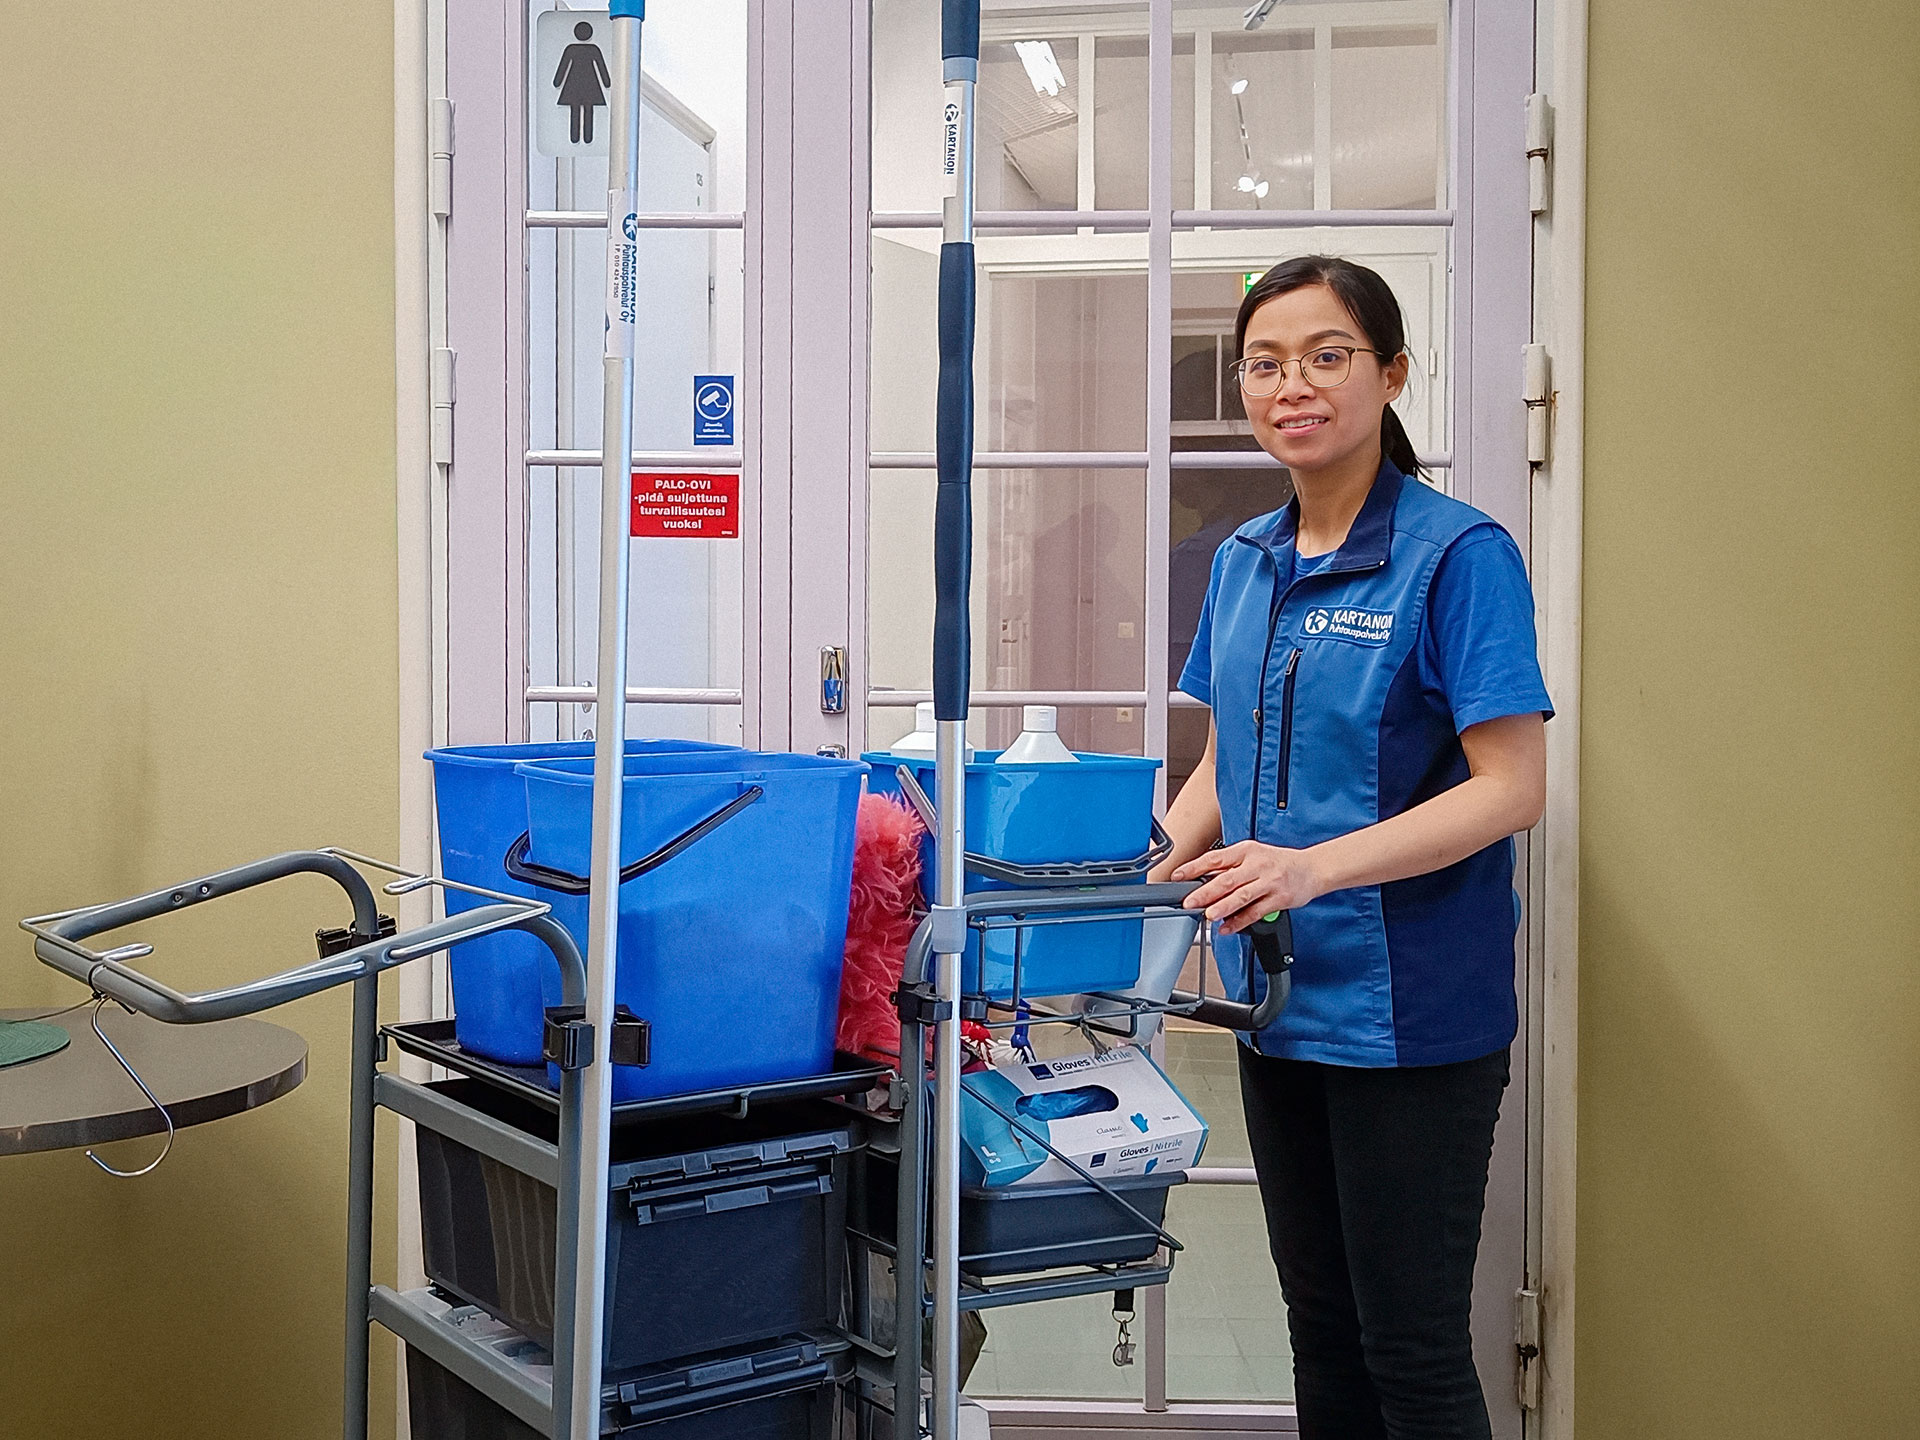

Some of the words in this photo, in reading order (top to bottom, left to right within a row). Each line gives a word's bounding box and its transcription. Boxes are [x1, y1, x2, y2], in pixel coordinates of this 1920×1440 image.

[946, 124, 957, 175] KARTANON
[619, 310, 630, 323] Oy
[654, 479, 712, 490] PALO-OVI
[667, 493, 728, 505] suljettuna
[639, 506, 726, 516] turvallisuutesi
[662, 520, 702, 529] vuoksi
[1331, 609, 1394, 630] KARTANON
[1052, 1058, 1091, 1072] Gloves
[1095, 1050, 1133, 1064] Nitrile
[1119, 1145, 1150, 1158] Gloves
[1154, 1139, 1184, 1151] Nitrile
